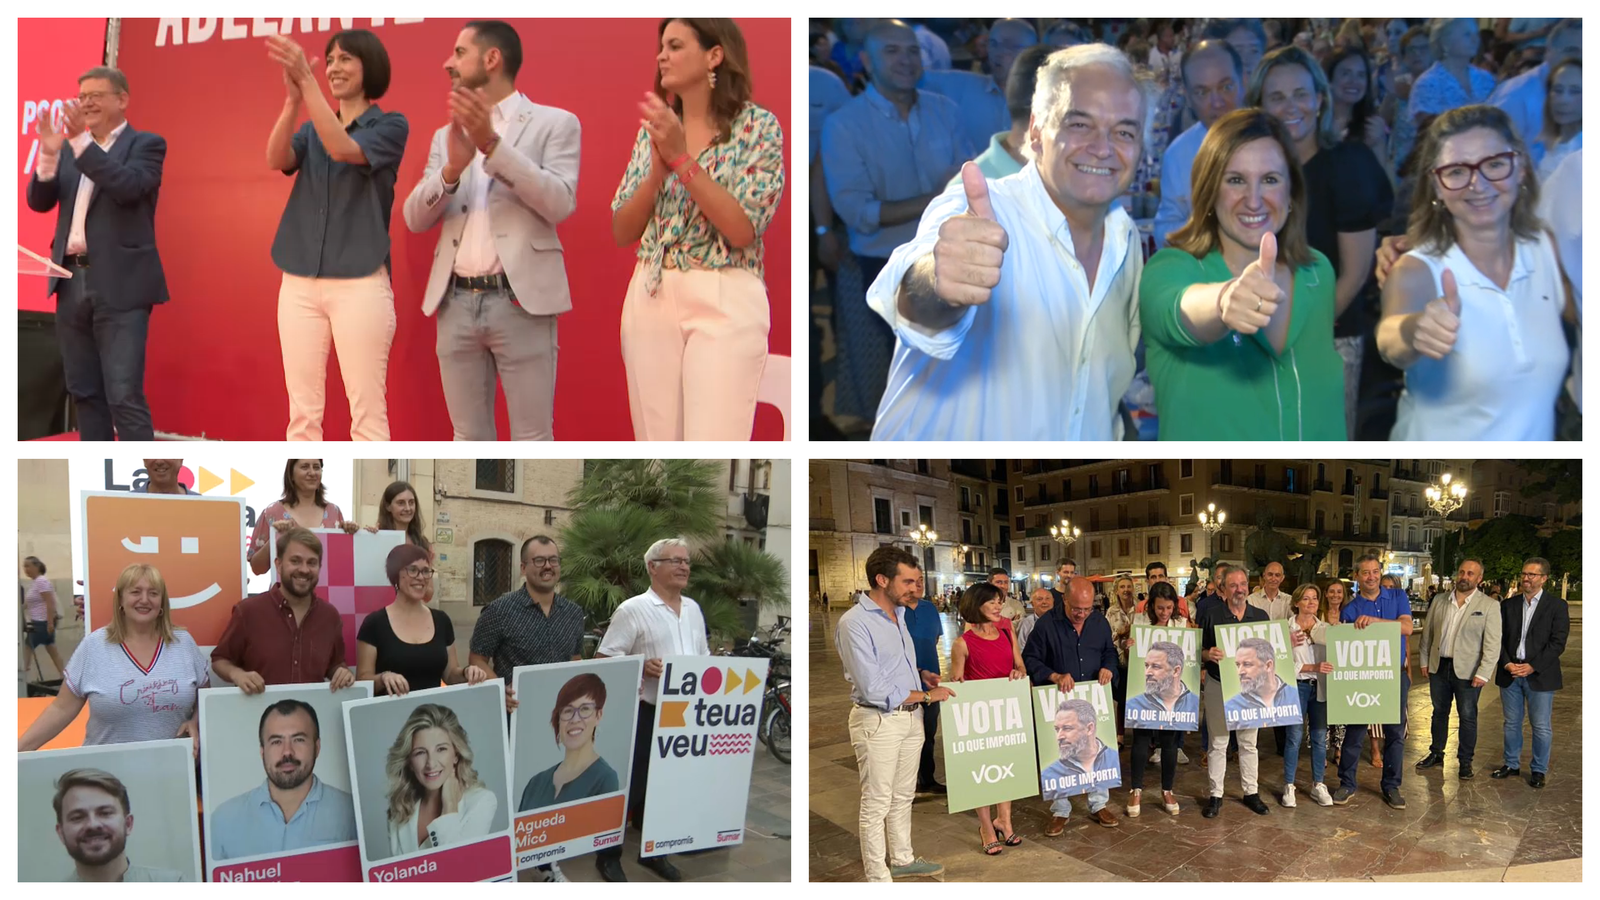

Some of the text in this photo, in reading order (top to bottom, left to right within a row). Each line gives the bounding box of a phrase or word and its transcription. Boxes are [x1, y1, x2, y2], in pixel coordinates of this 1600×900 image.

[1335, 640, 1391, 667] VOTA
[663, 663, 697, 695] La
[1333, 670, 1394, 681] LO QUE IMPORTA
[1346, 691, 1381, 708] VOX
[694, 698, 756, 727] teua
[952, 697, 1024, 737] VOTA
[1128, 708, 1196, 725] LO QUE IMPORTA
[1228, 704, 1299, 722] LO QUE IMPORTA
[657, 734, 708, 759] veu
[952, 732, 1027, 755] LO QUE IMPORTA
[971, 763, 1015, 784] VOX
[1045, 767, 1118, 791] LO QUE IMPORTA
[515, 813, 566, 834] Agueda
[515, 831, 547, 848] Micó
[593, 833, 621, 848] Sumar
[717, 833, 741, 843] Sumar
[520, 845, 566, 864] compromís
[220, 862, 281, 882] Nahuel
[373, 860, 437, 882] Yolanda
